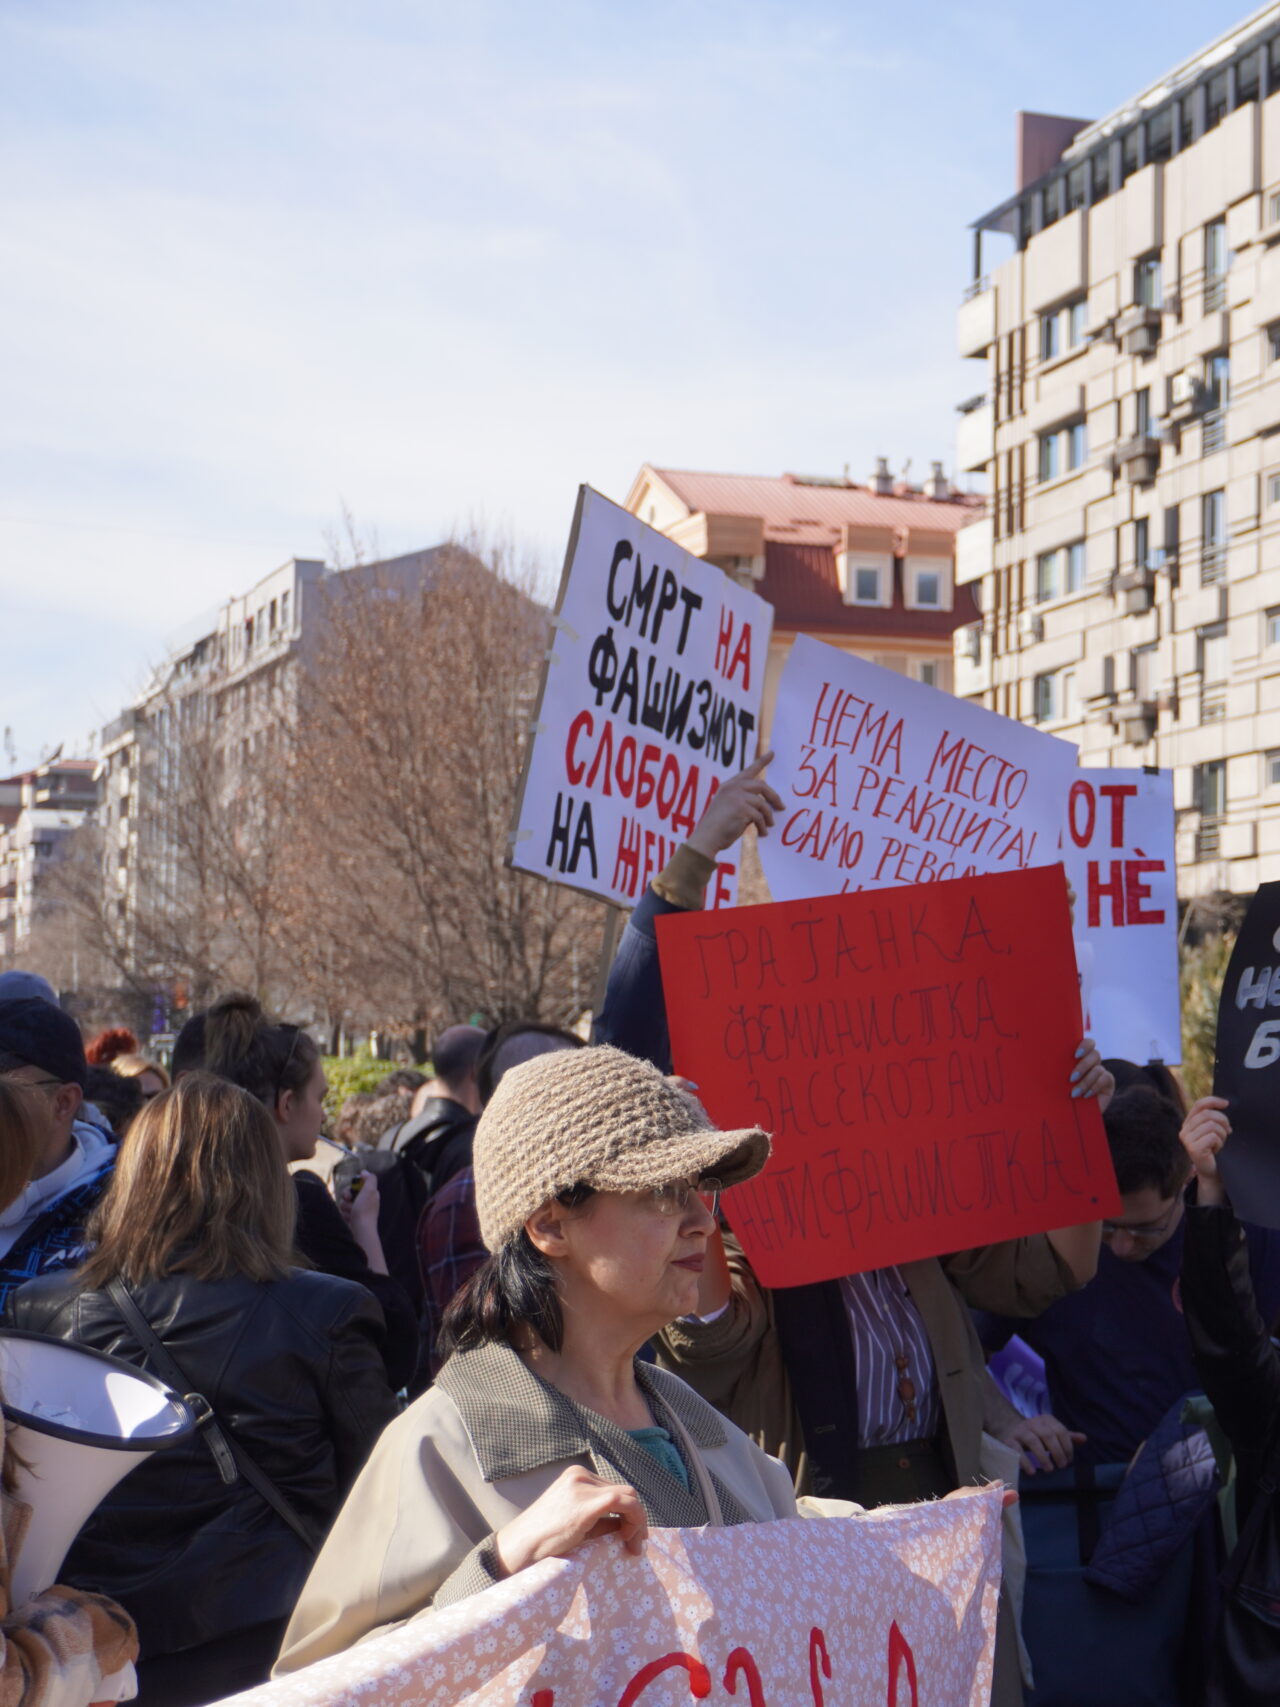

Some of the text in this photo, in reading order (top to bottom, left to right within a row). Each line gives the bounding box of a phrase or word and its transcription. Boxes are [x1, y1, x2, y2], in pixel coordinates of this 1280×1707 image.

[607, 540, 751, 691] СМРТ НА
[588, 626, 754, 772] ФАШИЗМОТ
[809, 682, 1028, 810] НЕМА МЕСТО
[792, 745, 837, 807] ЗА
[546, 792, 597, 879] НА
[781, 808, 863, 869] САМО
